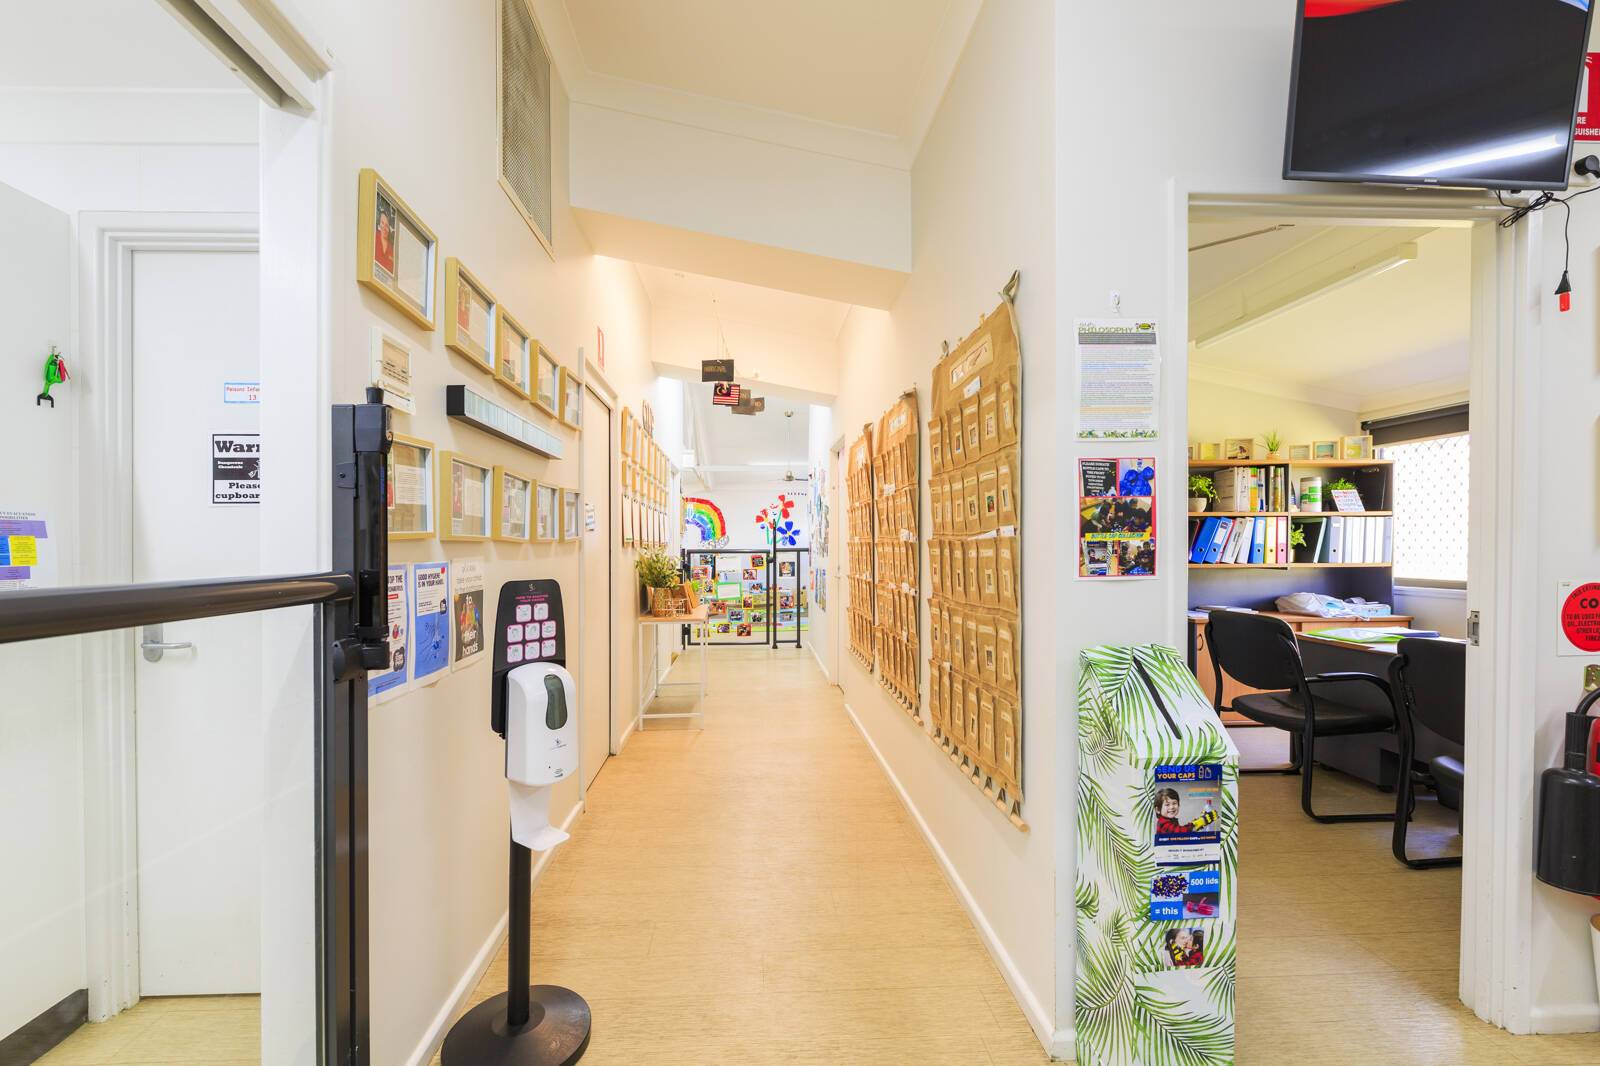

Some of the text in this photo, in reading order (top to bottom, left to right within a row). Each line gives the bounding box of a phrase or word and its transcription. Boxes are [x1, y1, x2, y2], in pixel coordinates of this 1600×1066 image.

[1078, 326, 1133, 334] PHILOSOPHY
[465, 594, 473, 605] to
[462, 643, 478, 656] hands
[1156, 764, 1196, 774] SEND US
[1190, 876, 1219, 886] 500 lids
[1162, 906, 1179, 915] this
